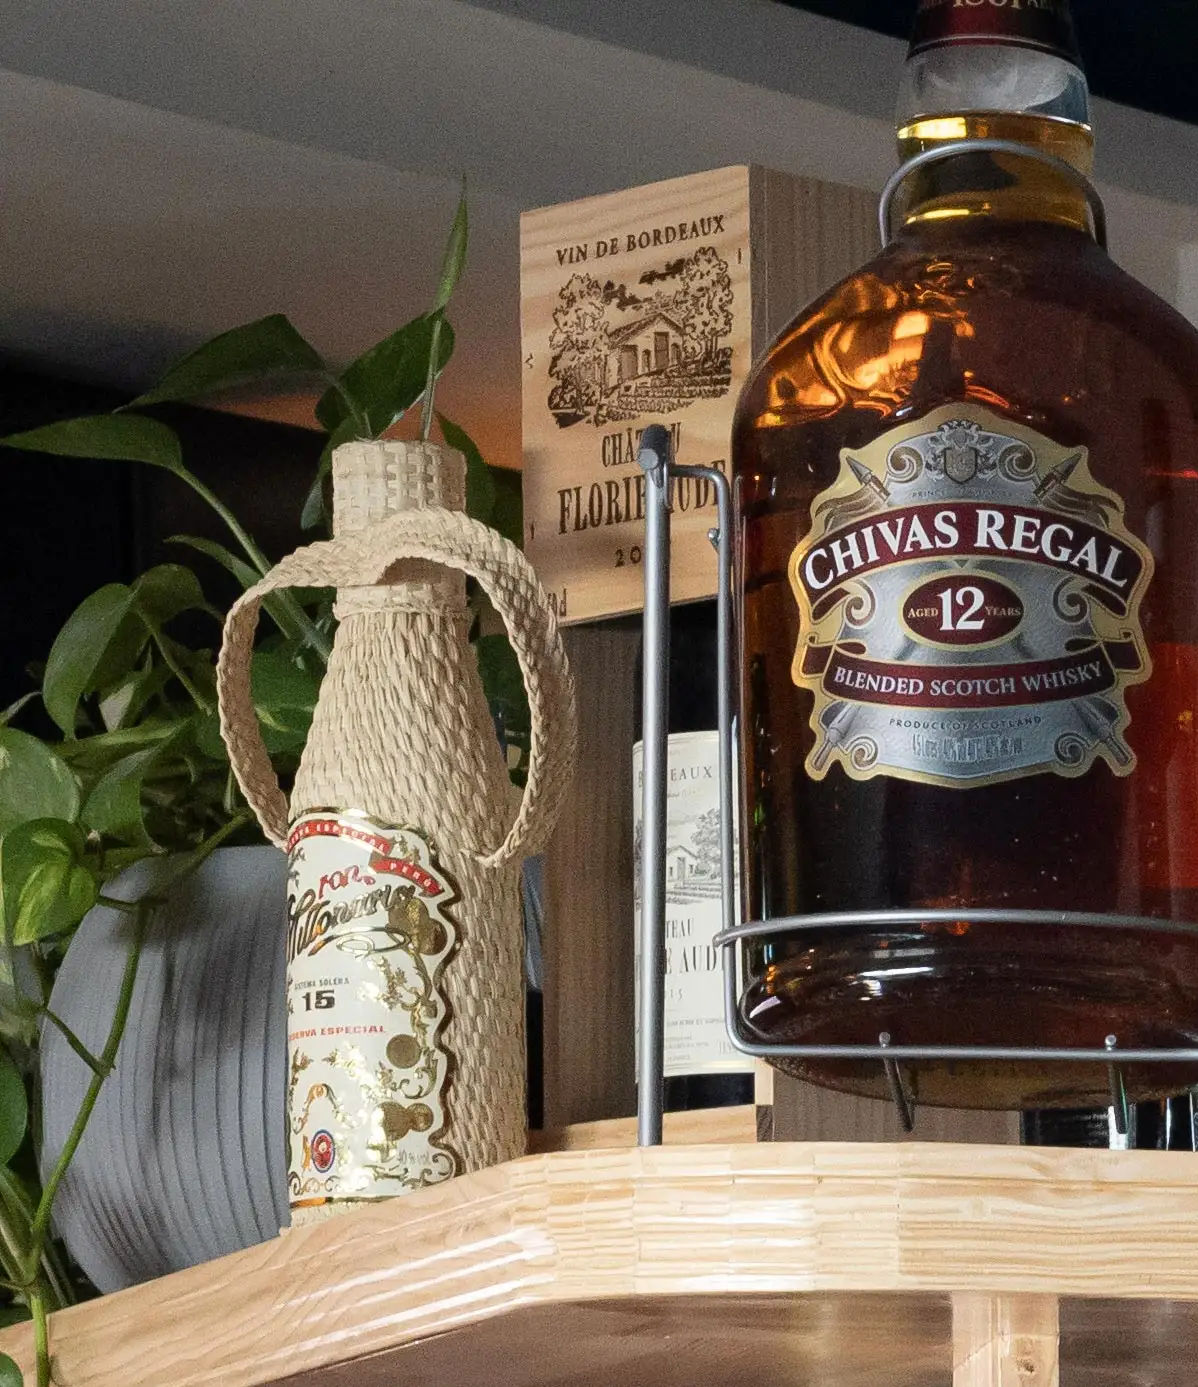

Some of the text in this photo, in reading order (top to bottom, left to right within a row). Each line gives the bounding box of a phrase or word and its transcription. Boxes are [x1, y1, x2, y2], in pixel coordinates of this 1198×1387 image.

[556, 214, 725, 267] VIN DE BORDEAUX
[804, 509, 1128, 590] CHIVAS REGAL
[907, 586, 1021, 631] AGED 12 YEARS
[834, 661, 1104, 697] BLENDED SCOTCH WHISKY
[319, 976, 350, 987] SOLERA
[302, 989, 336, 1011] 15
[320, 1025, 384, 1036] ESPECIAL
